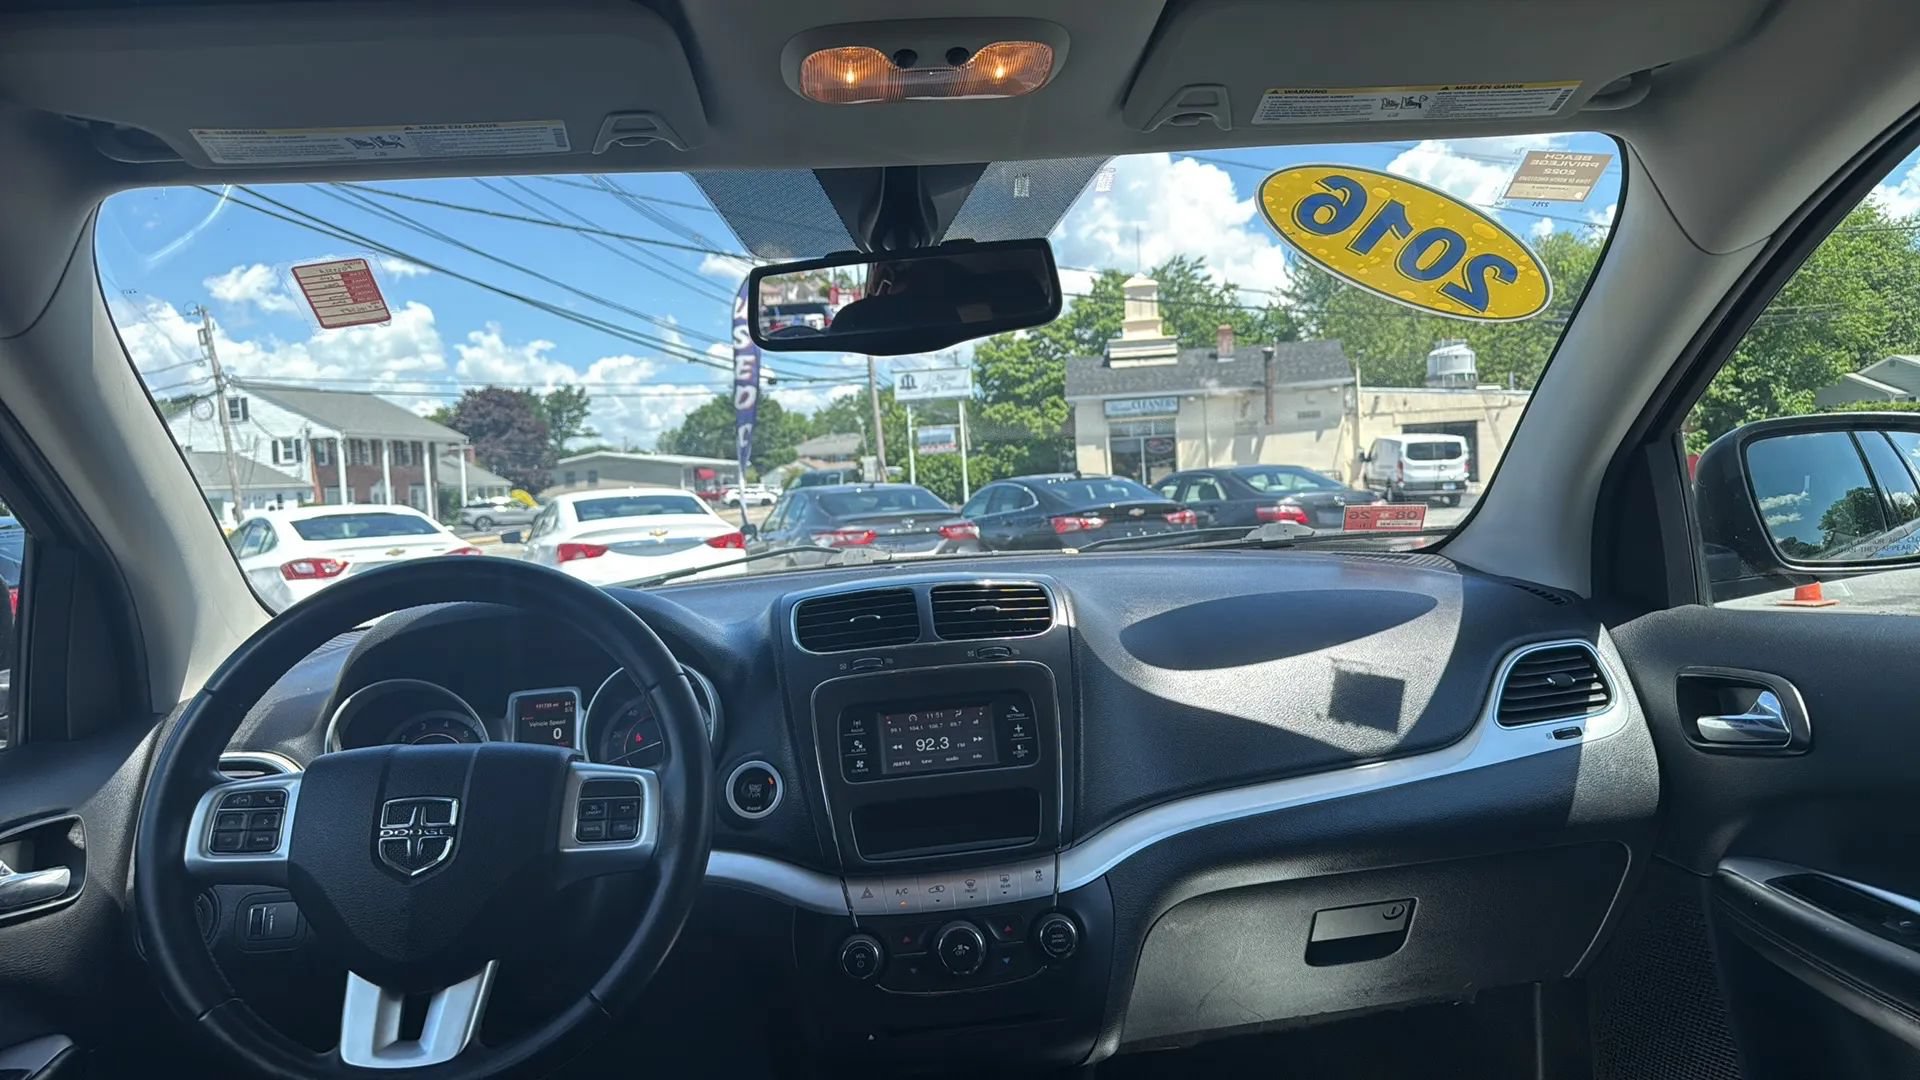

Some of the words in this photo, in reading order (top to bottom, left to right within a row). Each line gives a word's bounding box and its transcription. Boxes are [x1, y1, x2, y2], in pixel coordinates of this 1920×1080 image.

[1882, 543, 1911, 552] APPEAR
[442, 720, 449, 729] 4
[552, 727, 562, 740] 0
[915, 736, 950, 752] 92.3
[895, 887, 908, 896] A/C
